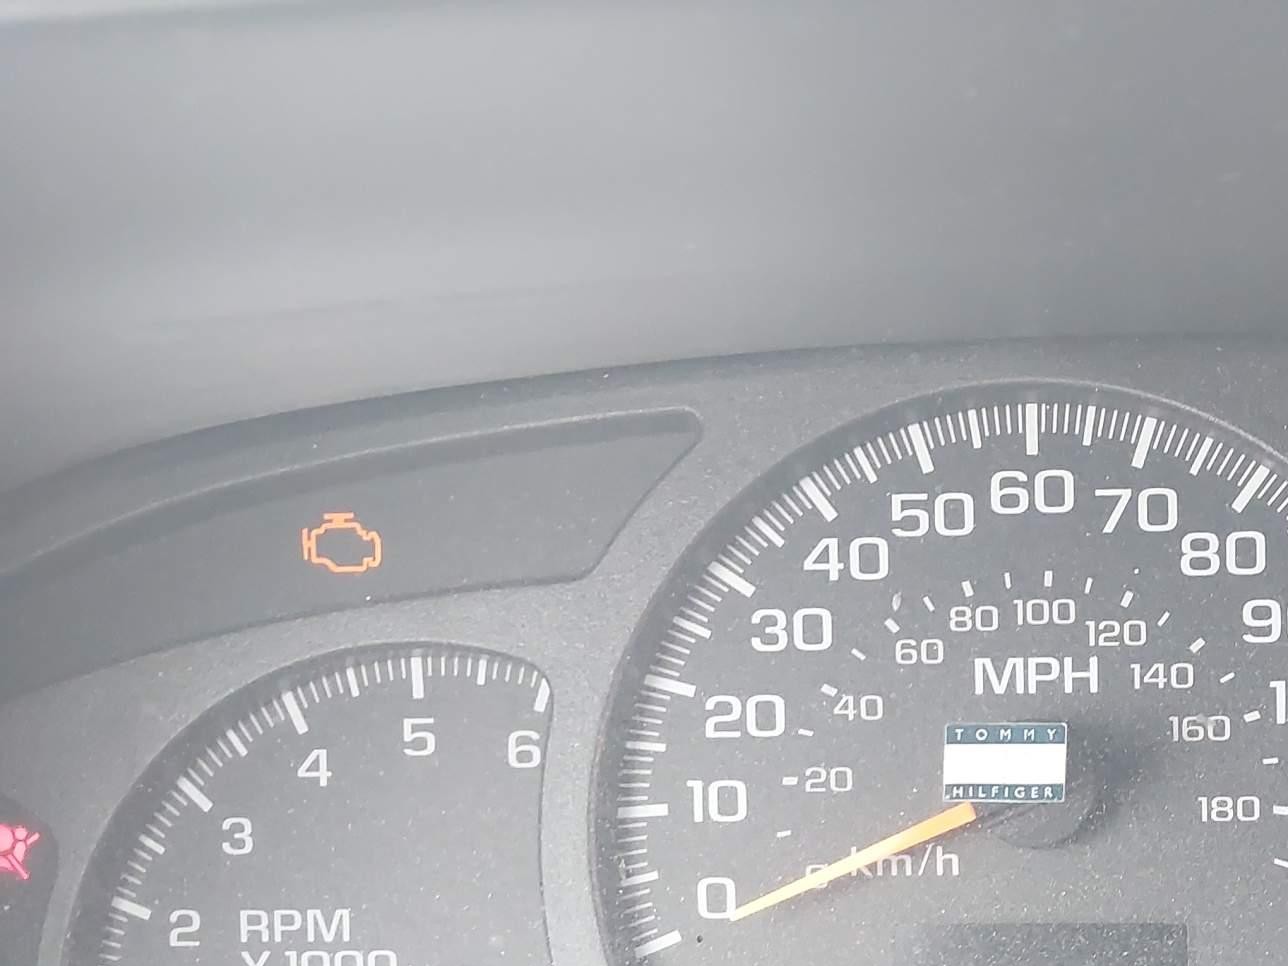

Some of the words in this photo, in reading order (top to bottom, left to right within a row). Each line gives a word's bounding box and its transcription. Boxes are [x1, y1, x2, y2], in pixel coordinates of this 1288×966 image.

[990, 469, 1075, 514] 60
[1094, 487, 1178, 533] 70
[890, 492, 975, 537] 50
[802, 537, 889, 581] 40
[1179, 531, 1266, 577] 80
[750, 607, 833, 652] 30
[949, 605, 999, 631] 80
[1013, 599, 1076, 625] 100
[895, 638, 944, 664] 60
[1085, 619, 1147, 647] 120
[973, 656, 1099, 695] MPH
[1130, 662, 1194, 689] 140
[705, 694, 786, 738] 20
[833, 695, 883, 721] 40
[402, 717, 437, 757] 5
[954, 727, 1057, 742] TOMMY
[1168, 715, 1231, 742] 160
[296, 748, 332, 787] 4
[506, 730, 542, 770] 6
[804, 767, 853, 792] 20
[952, 786, 1054, 799] HILFIGER
[686, 779, 748, 822] 10
[1198, 796, 1260, 822] 180
[221, 817, 254, 855] 3
[697, 876, 737, 919] 0
[169, 909, 201, 947] 2
[239, 908, 352, 943] RPM
